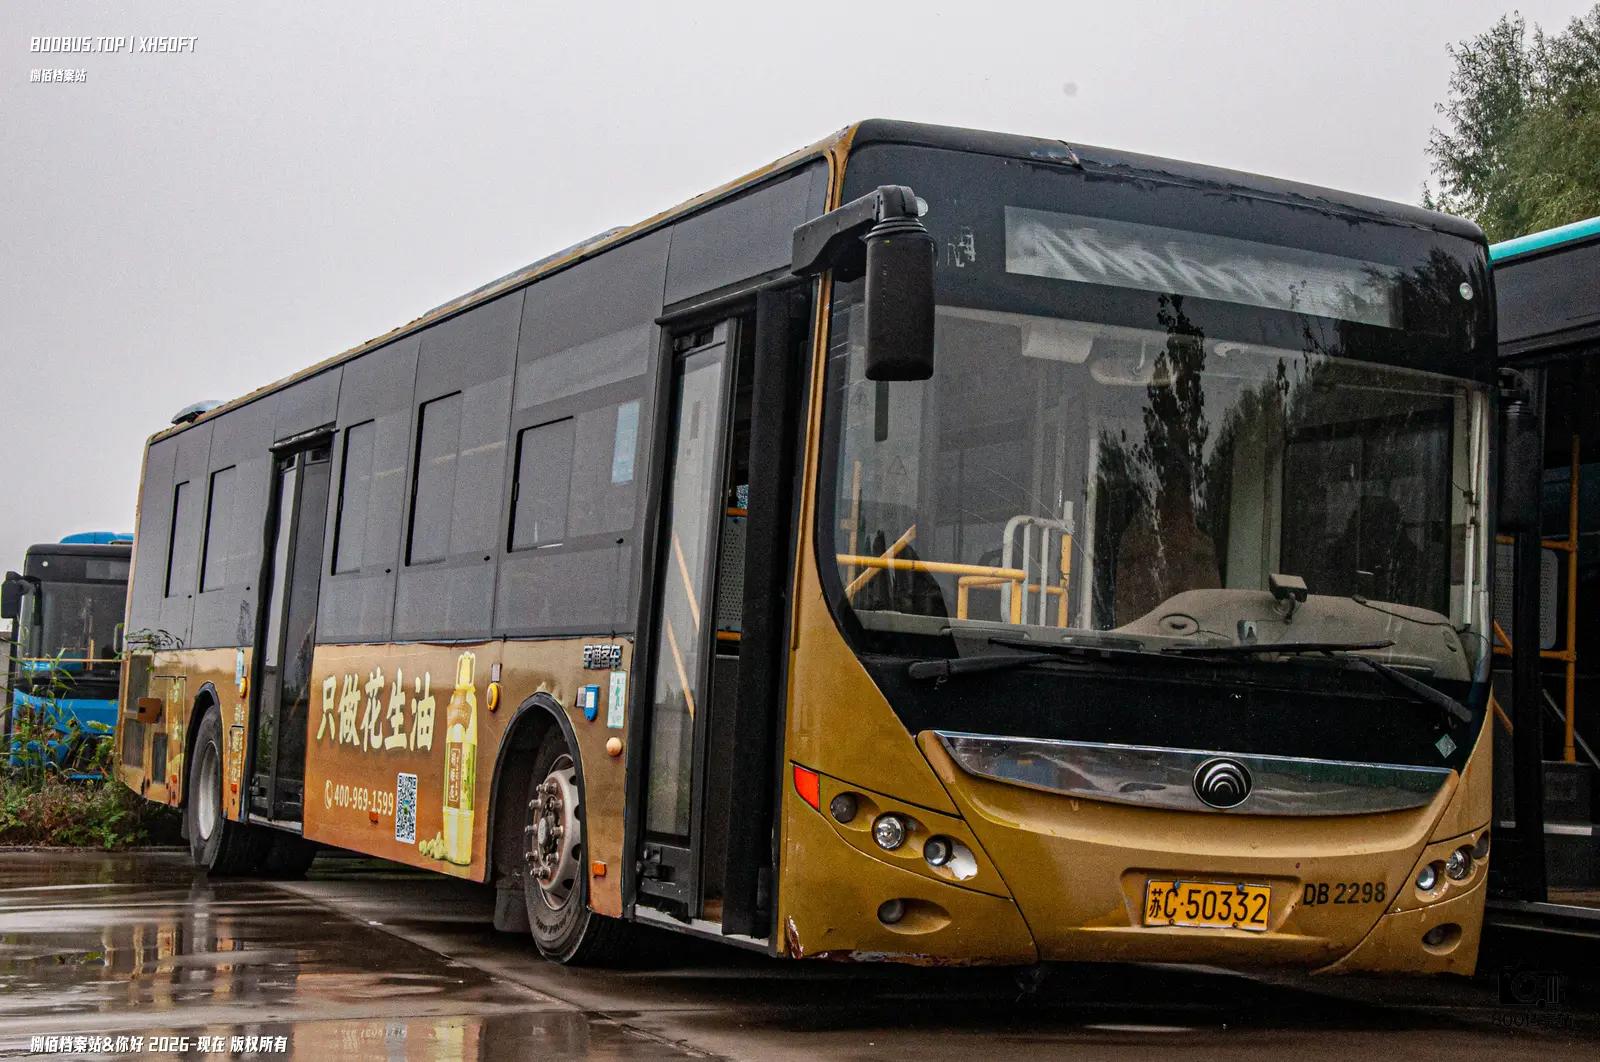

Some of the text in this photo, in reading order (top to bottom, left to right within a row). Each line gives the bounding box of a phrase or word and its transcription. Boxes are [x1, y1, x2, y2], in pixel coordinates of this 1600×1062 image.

[316, 667, 436, 752] 只做花生油
[334, 784, 394, 816] 400-969-1599
[1303, 881, 1386, 906] DB 2298
